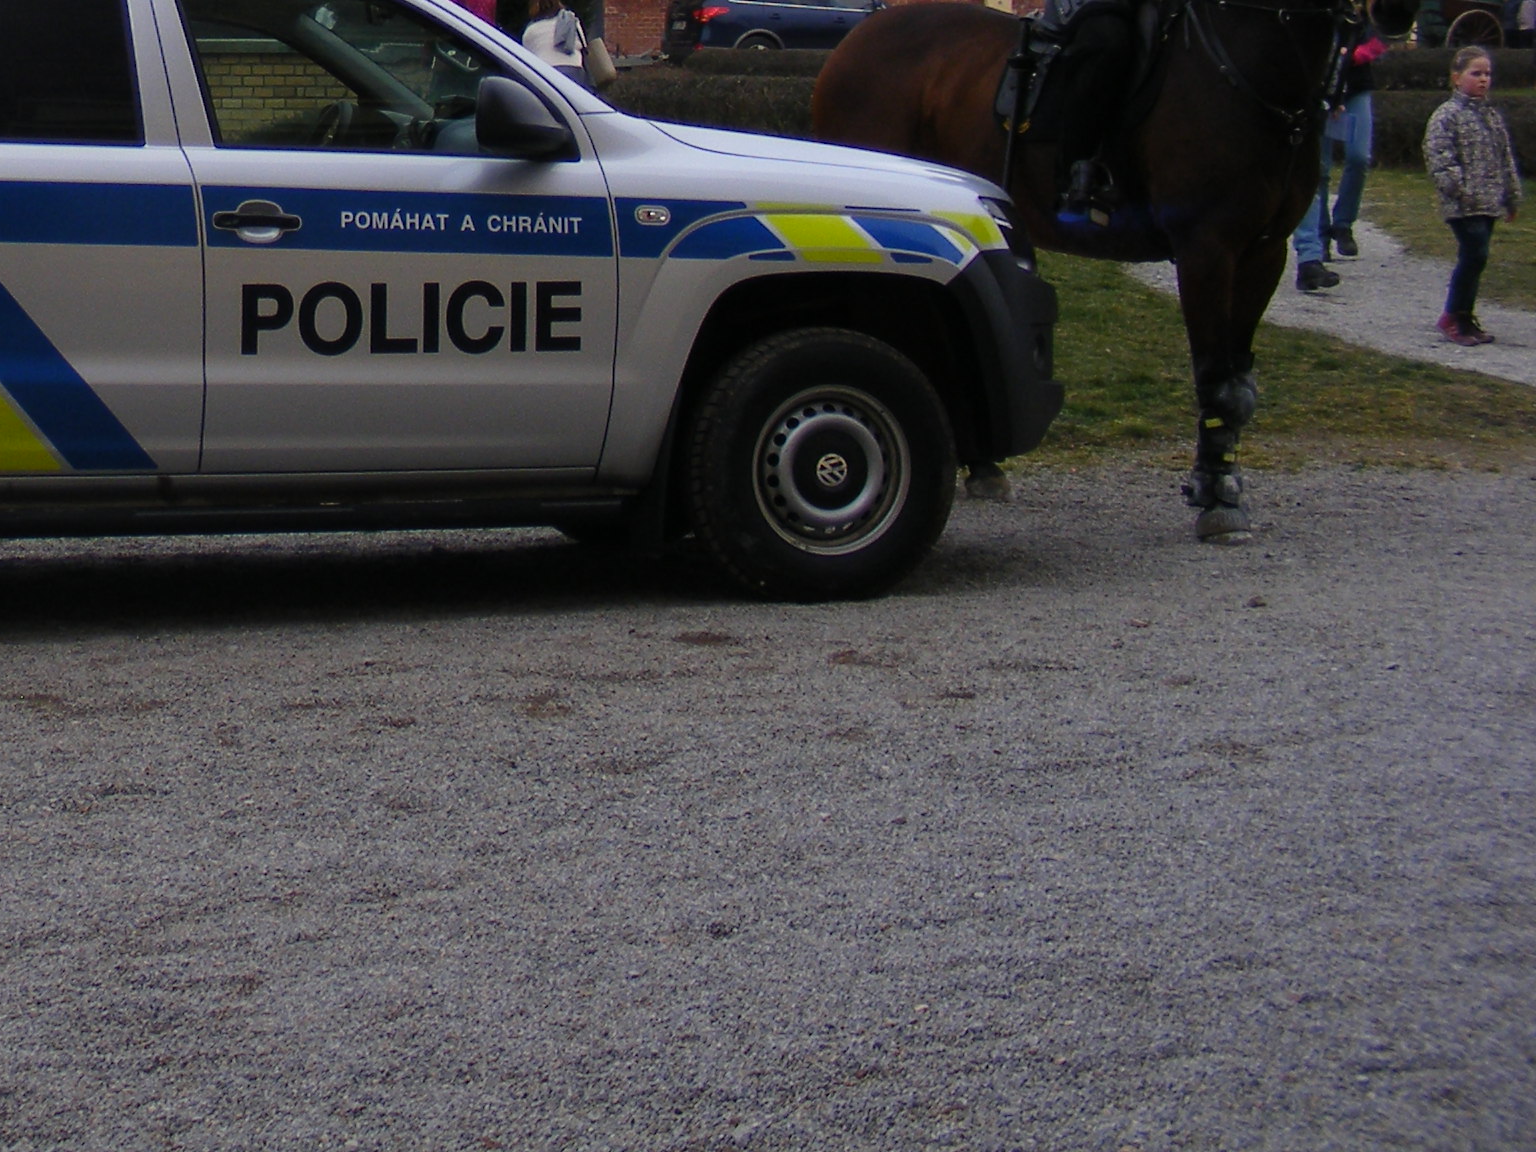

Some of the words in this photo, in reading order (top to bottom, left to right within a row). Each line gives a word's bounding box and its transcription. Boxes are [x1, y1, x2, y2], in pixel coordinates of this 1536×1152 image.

[340, 207, 450, 231] POMÁHAT
[460, 214, 476, 232] A
[487, 209, 583, 234] CHRÁNIT
[240, 280, 582, 357] POLICIE
